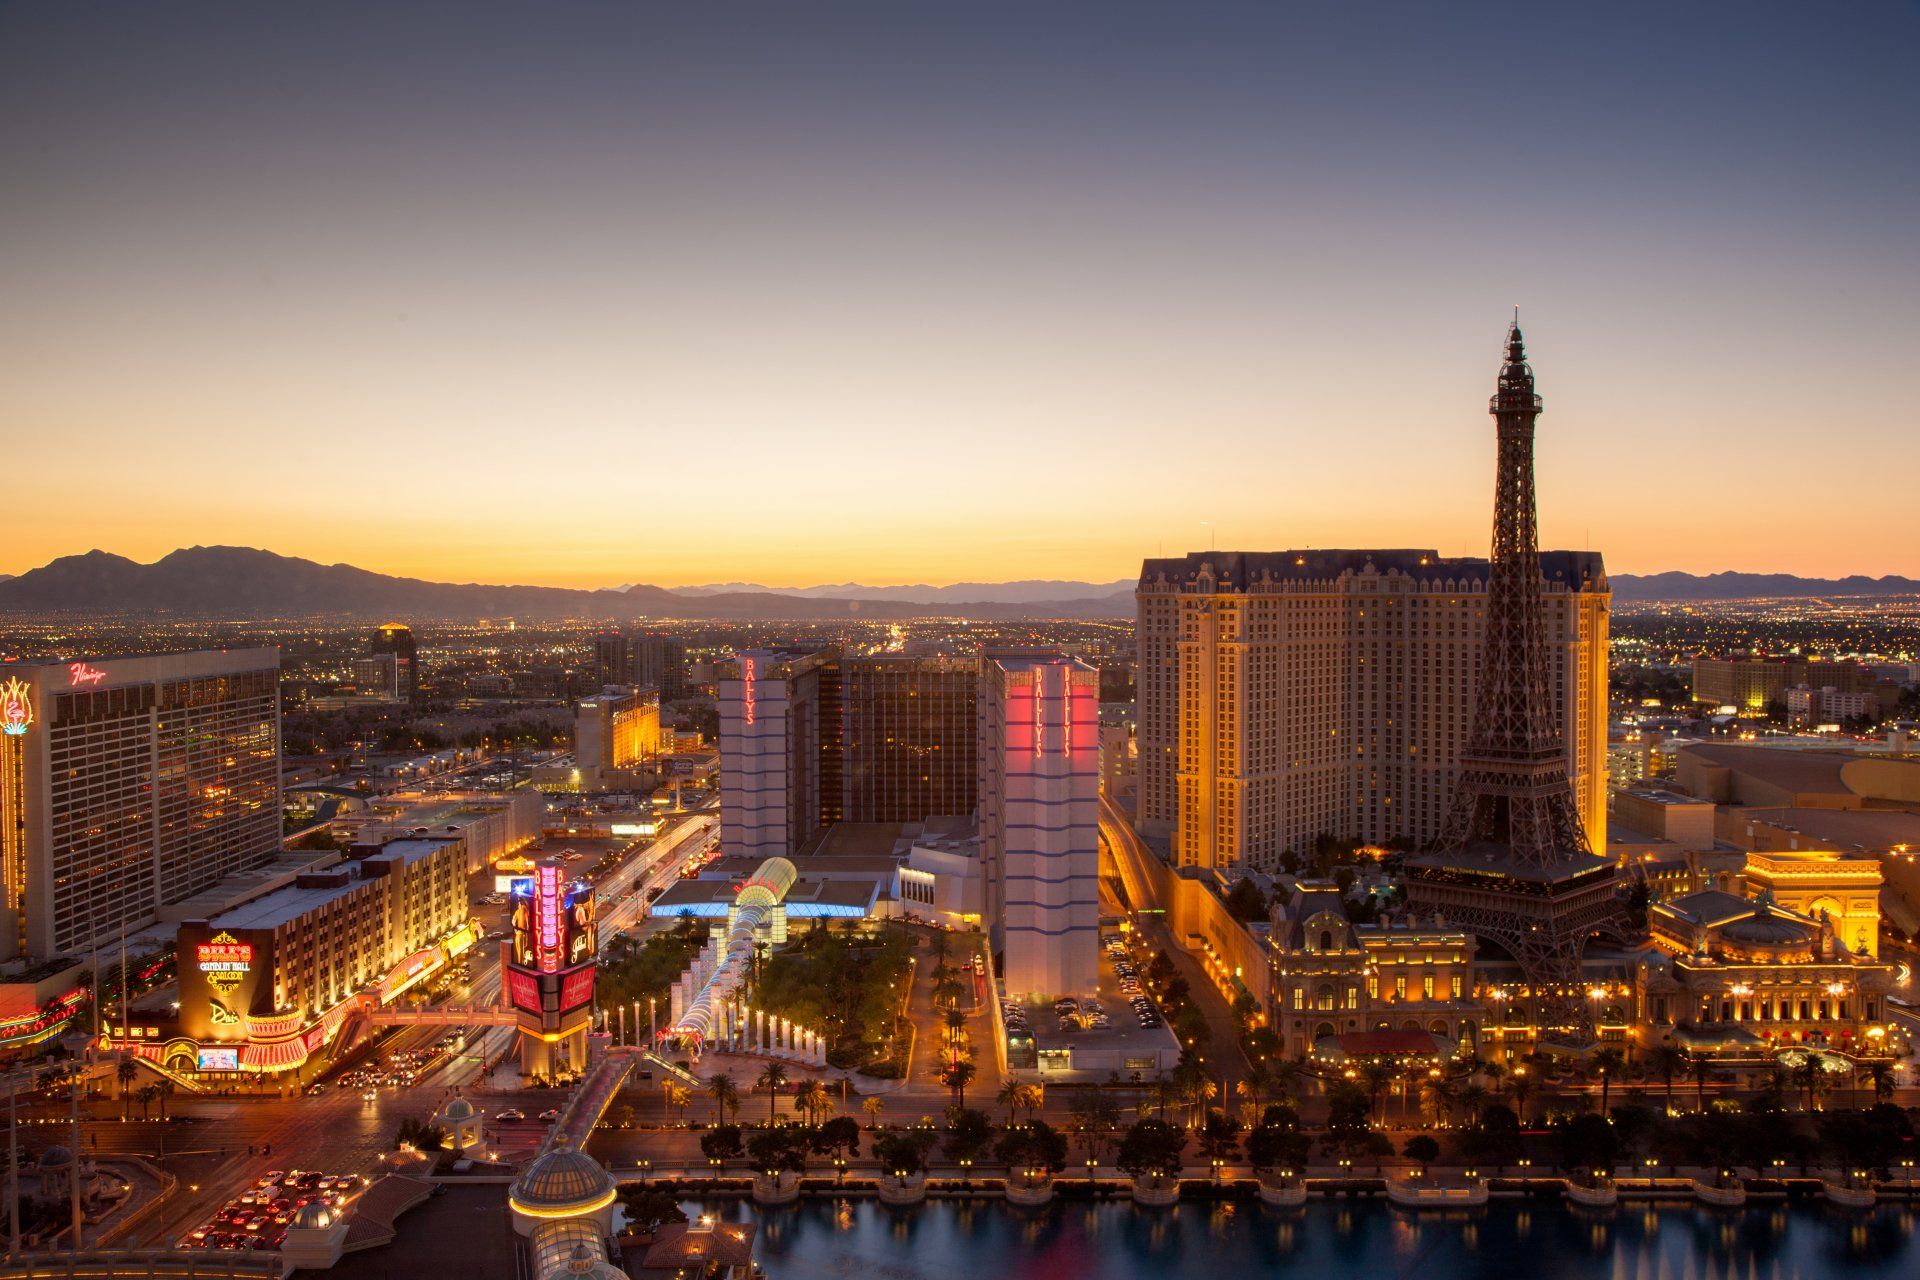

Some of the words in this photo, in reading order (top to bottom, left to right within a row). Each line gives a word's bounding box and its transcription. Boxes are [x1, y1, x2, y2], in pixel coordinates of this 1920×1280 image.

[745, 659, 755, 725] BALLYS
[197, 945, 252, 962] BILL'S
[216, 971, 243, 981] SALOON
